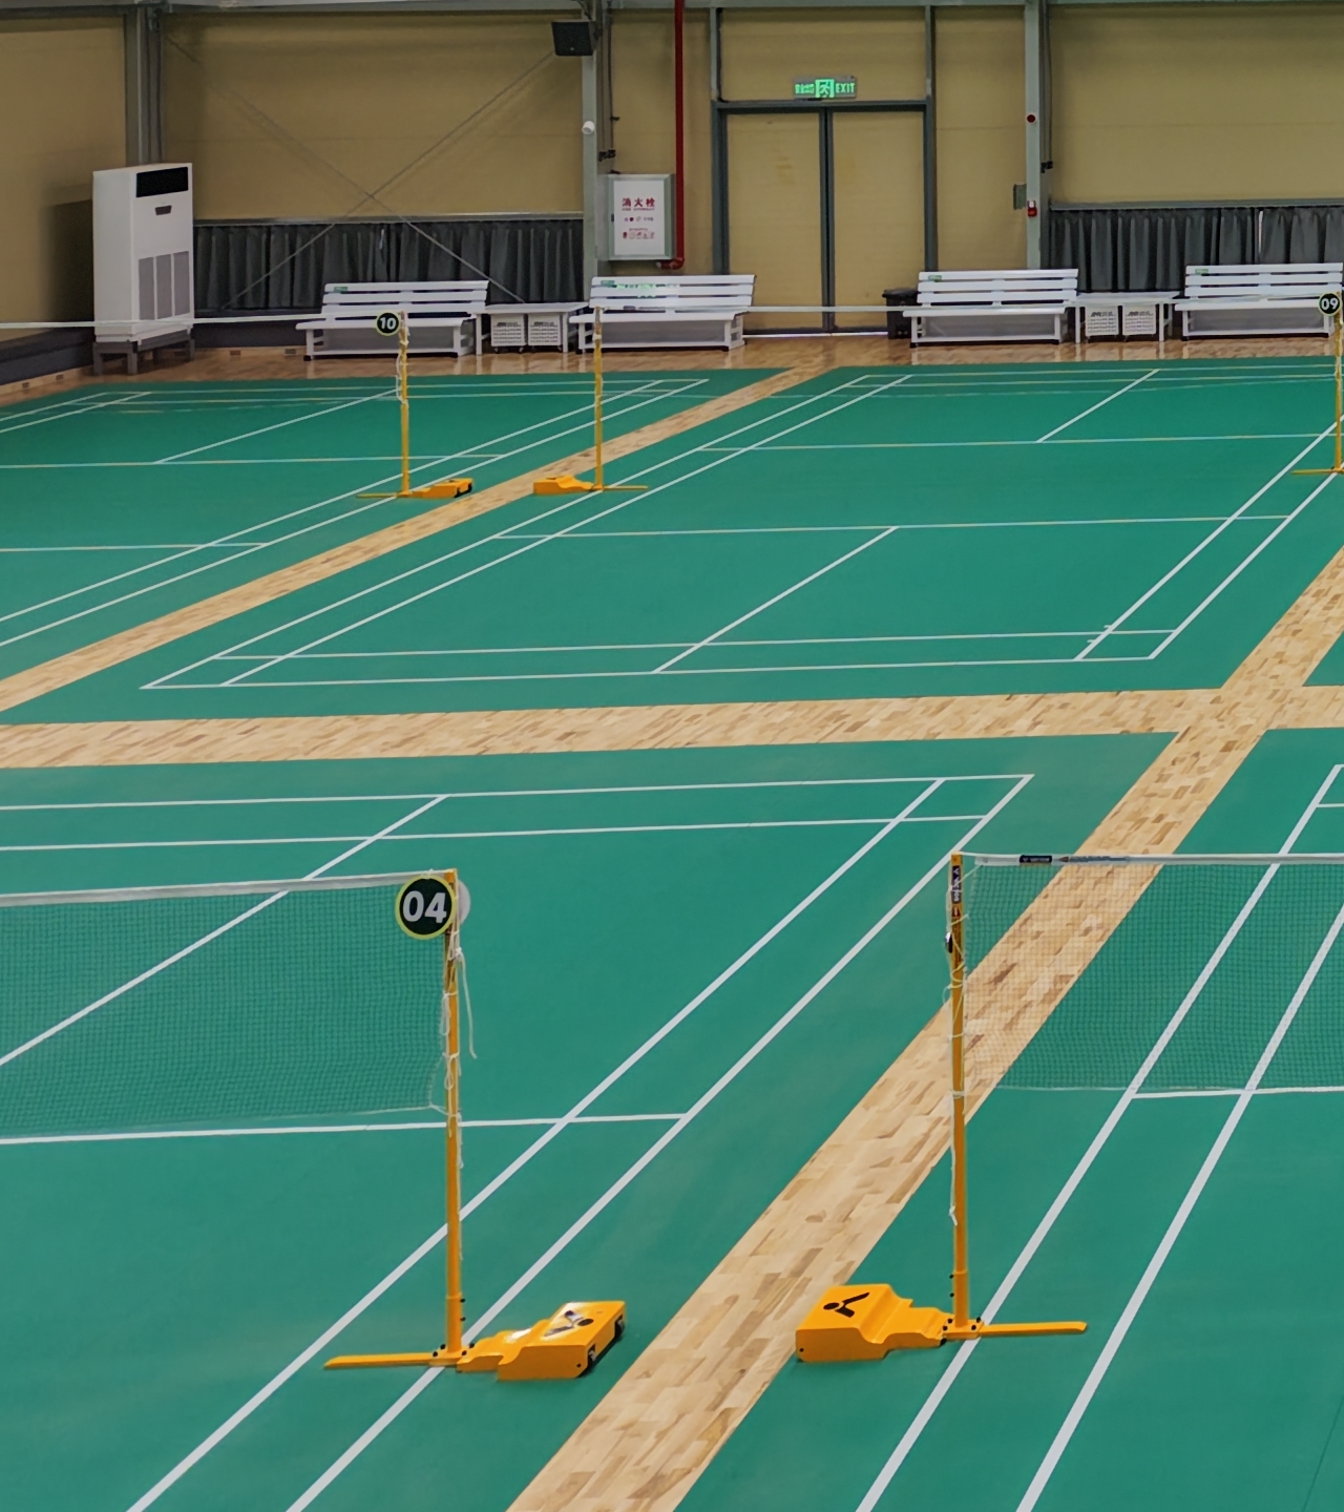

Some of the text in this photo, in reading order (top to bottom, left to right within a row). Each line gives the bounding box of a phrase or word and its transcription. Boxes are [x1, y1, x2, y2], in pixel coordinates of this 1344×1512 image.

[836, 83, 855, 93] EXIT
[622, 197, 655, 208] 消火栓
[1320, 297, 1339, 311] 09
[380, 317, 397, 330] 10
[402, 890, 448, 924] 04
